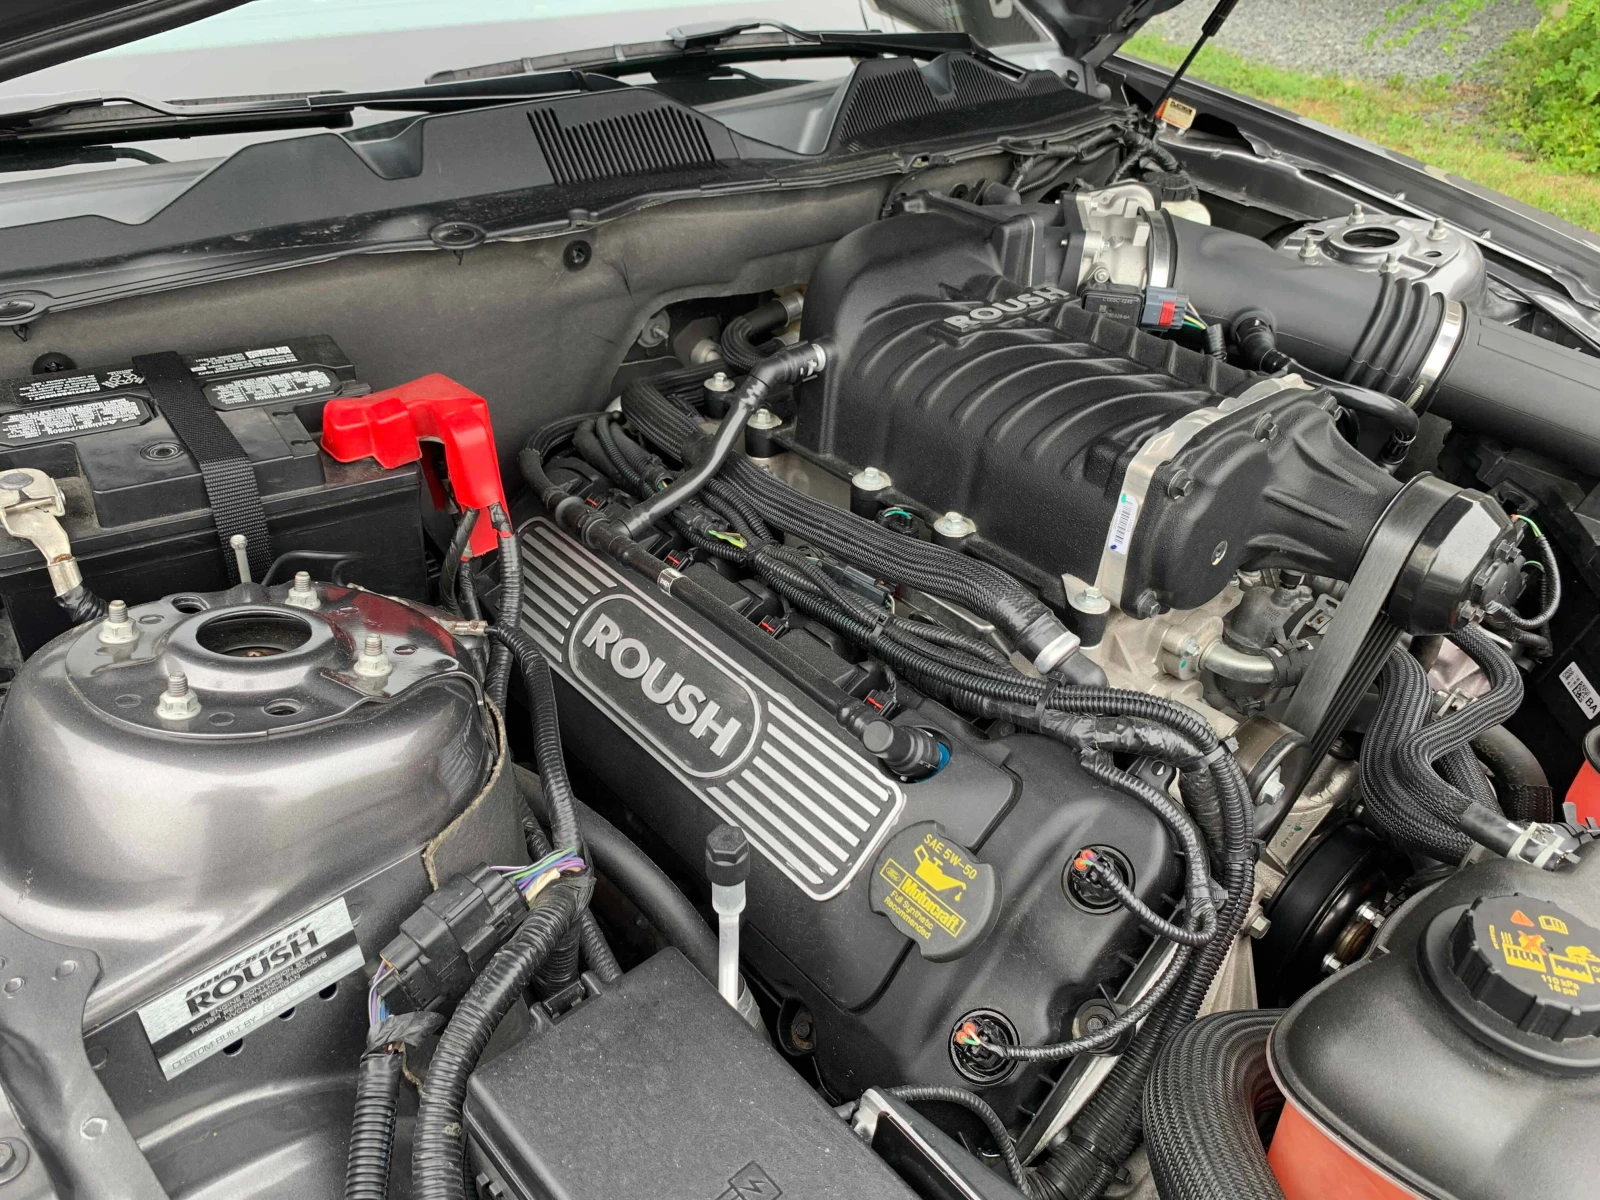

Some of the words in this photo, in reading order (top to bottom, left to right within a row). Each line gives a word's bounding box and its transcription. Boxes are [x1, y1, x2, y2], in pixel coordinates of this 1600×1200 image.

[943, 286, 1070, 332] ROUSH
[582, 613, 742, 757] ROUSH
[1585, 697, 1597, 713] BA
[924, 834, 944, 854] SAE
[943, 849, 978, 880] 5W-50
[884, 896, 931, 939] Recommended
[890, 890, 903, 902] Full
[902, 901, 934, 930] Synthetic
[901, 878, 960, 932] Motorcraft
[186, 940, 281, 998] POWERED
[186, 930, 318, 1016] ROUSH
[190, 1014, 221, 1034] ROUSH
[223, 977, 284, 1014] PERFORMANCE
[286, 951, 328, 979] PRODUCTS
[210, 996, 241, 1017] ENGINE
[243, 965, 294, 997] CONVERSION
[261, 974, 301, 1000] MICHIGAN
[1541, 974, 1559, 985] 110
[1560, 978, 1580, 991] kPa
[171, 1041, 214, 1070] CUSTOM
[215, 1025, 242, 1045] BUILT
[244, 1016, 256, 1028] BY
